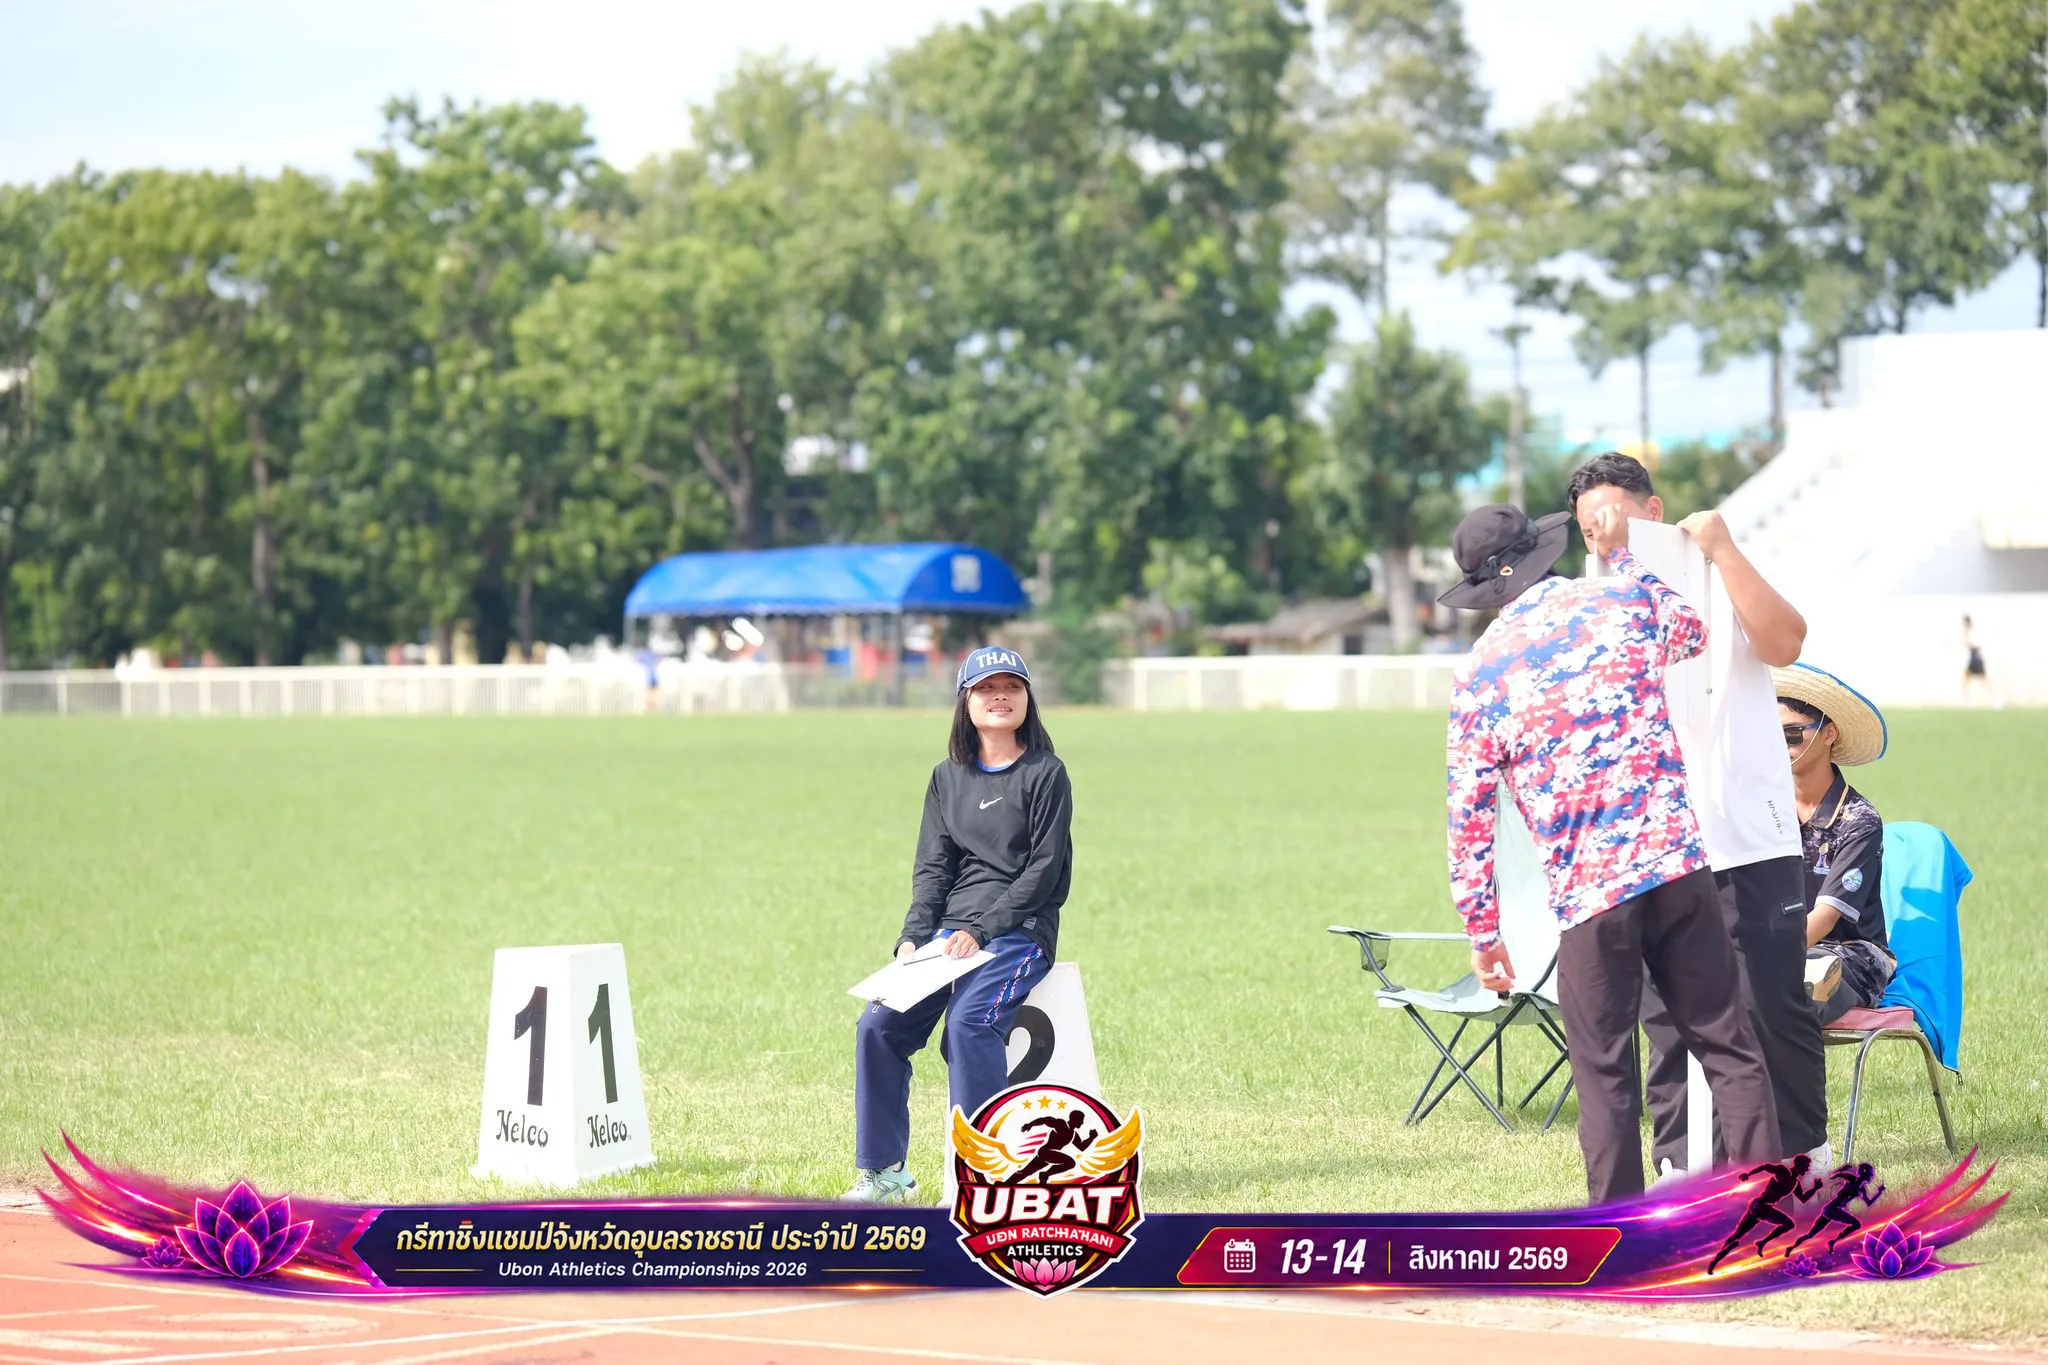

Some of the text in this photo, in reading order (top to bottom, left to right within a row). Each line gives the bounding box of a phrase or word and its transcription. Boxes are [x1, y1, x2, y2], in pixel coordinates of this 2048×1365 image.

[976, 652, 1017, 668] THAI
[514, 986, 548, 1106] 1
[588, 983, 618, 1104] 1
[496, 1109, 549, 1148] Nelco
[587, 1114, 628, 1148] Nelco
